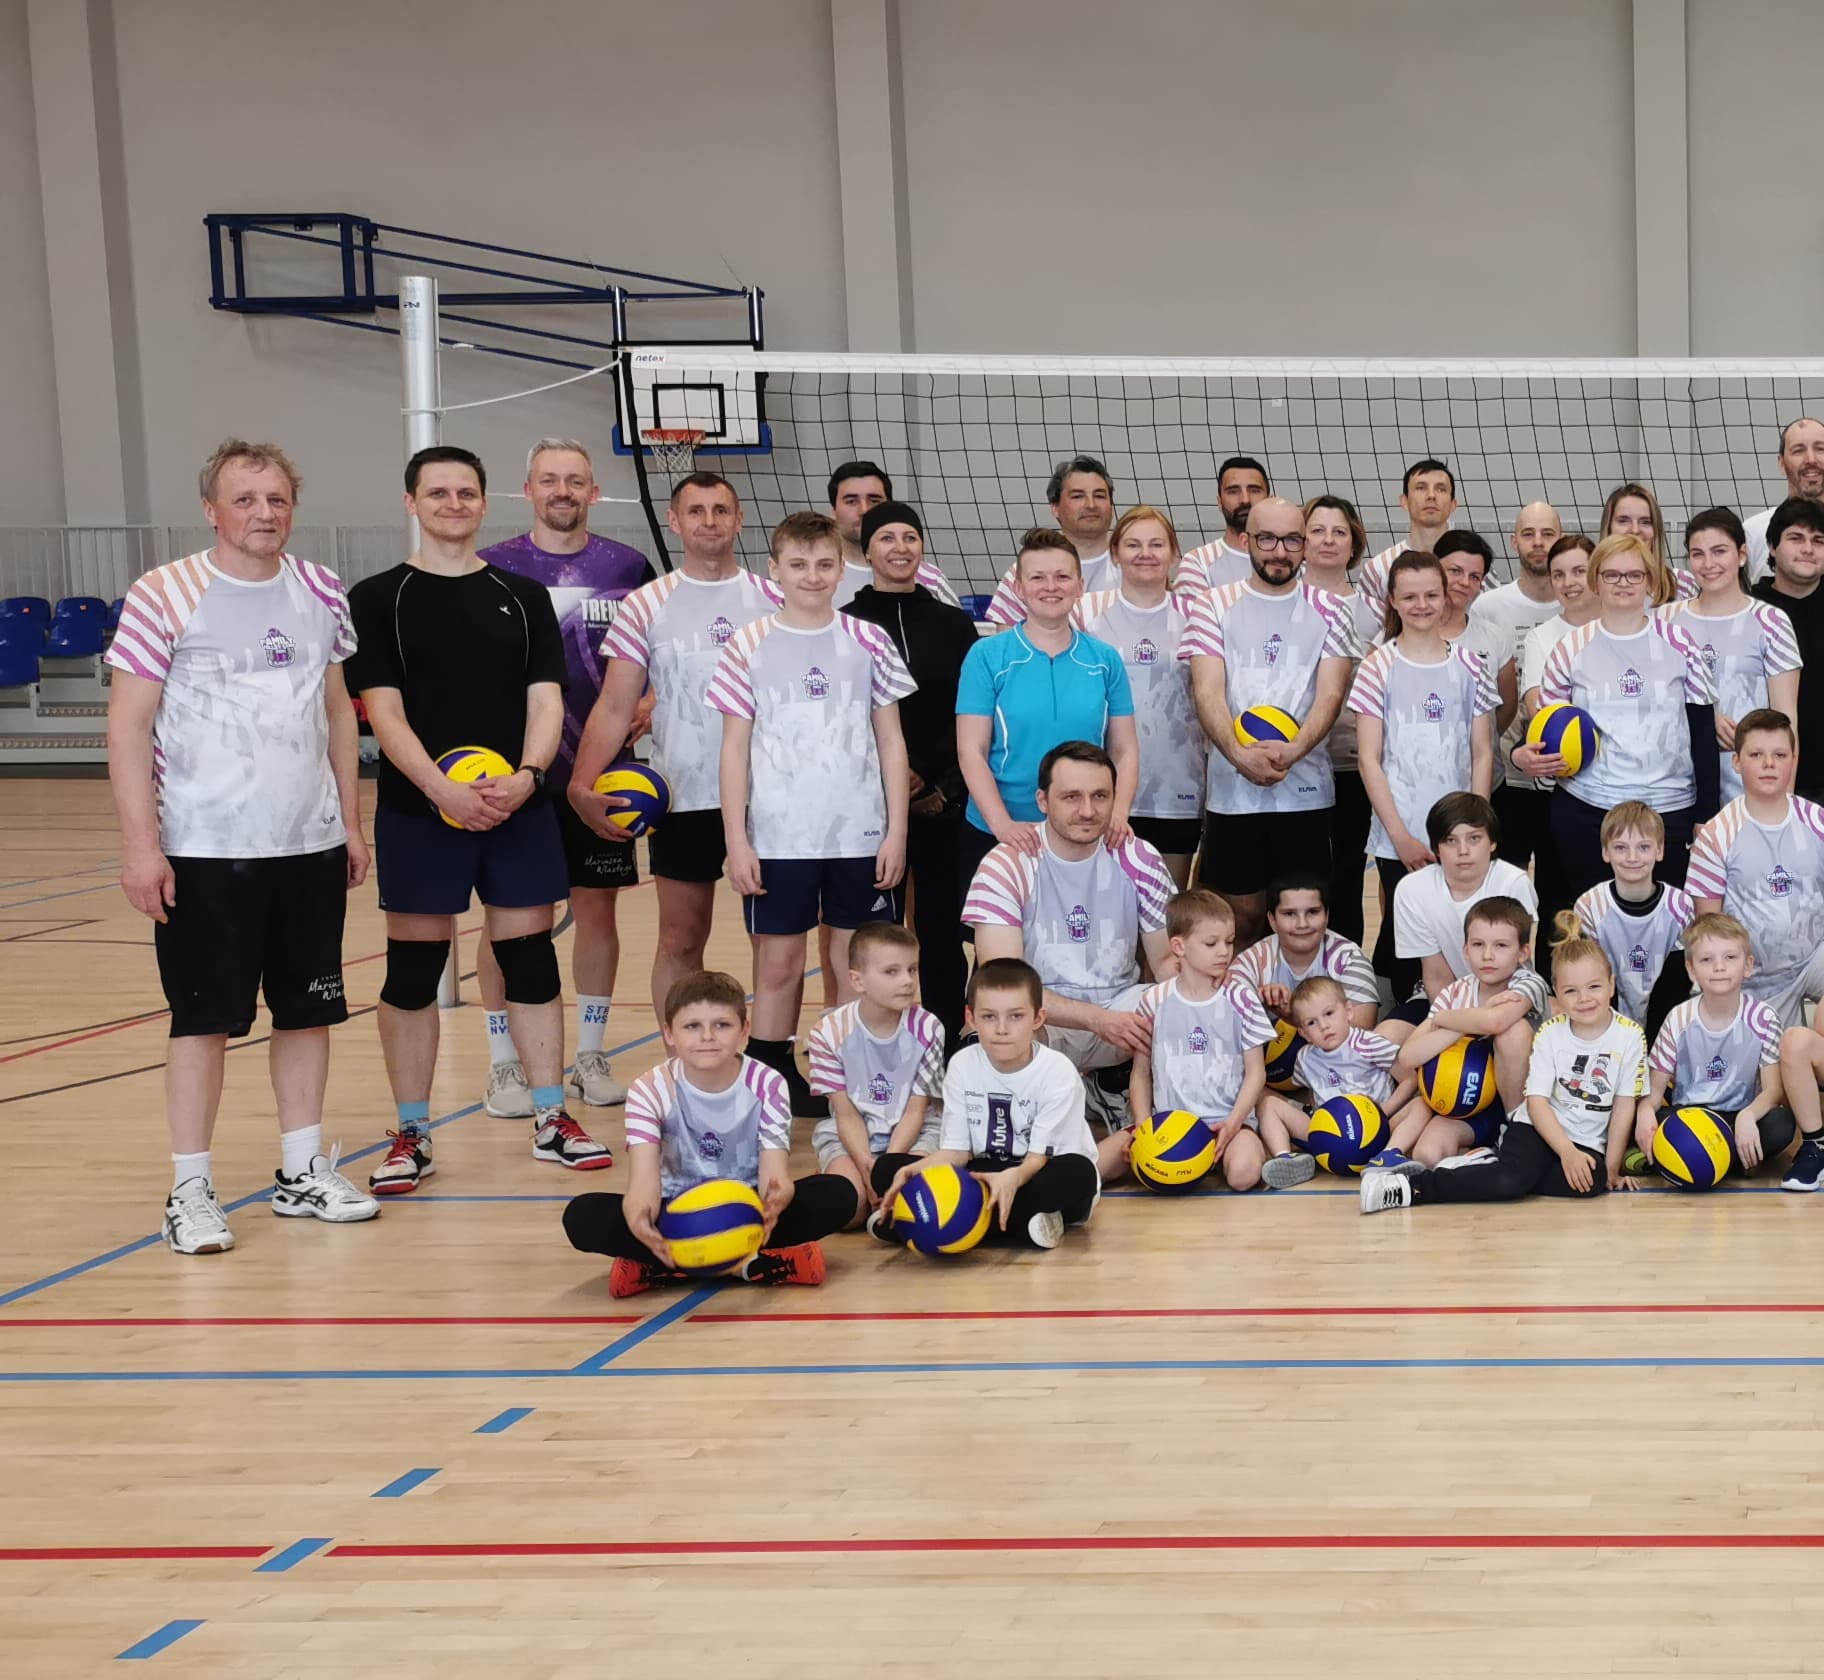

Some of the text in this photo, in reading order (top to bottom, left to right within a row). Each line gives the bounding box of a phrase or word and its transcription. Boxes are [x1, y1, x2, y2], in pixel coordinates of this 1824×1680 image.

[635, 355, 665, 364] netex
[489, 1015, 508, 1026] ST
[584, 1014, 609, 1025] NYS
[490, 1025, 510, 1036] NY
[989, 1106, 1007, 1148] future
